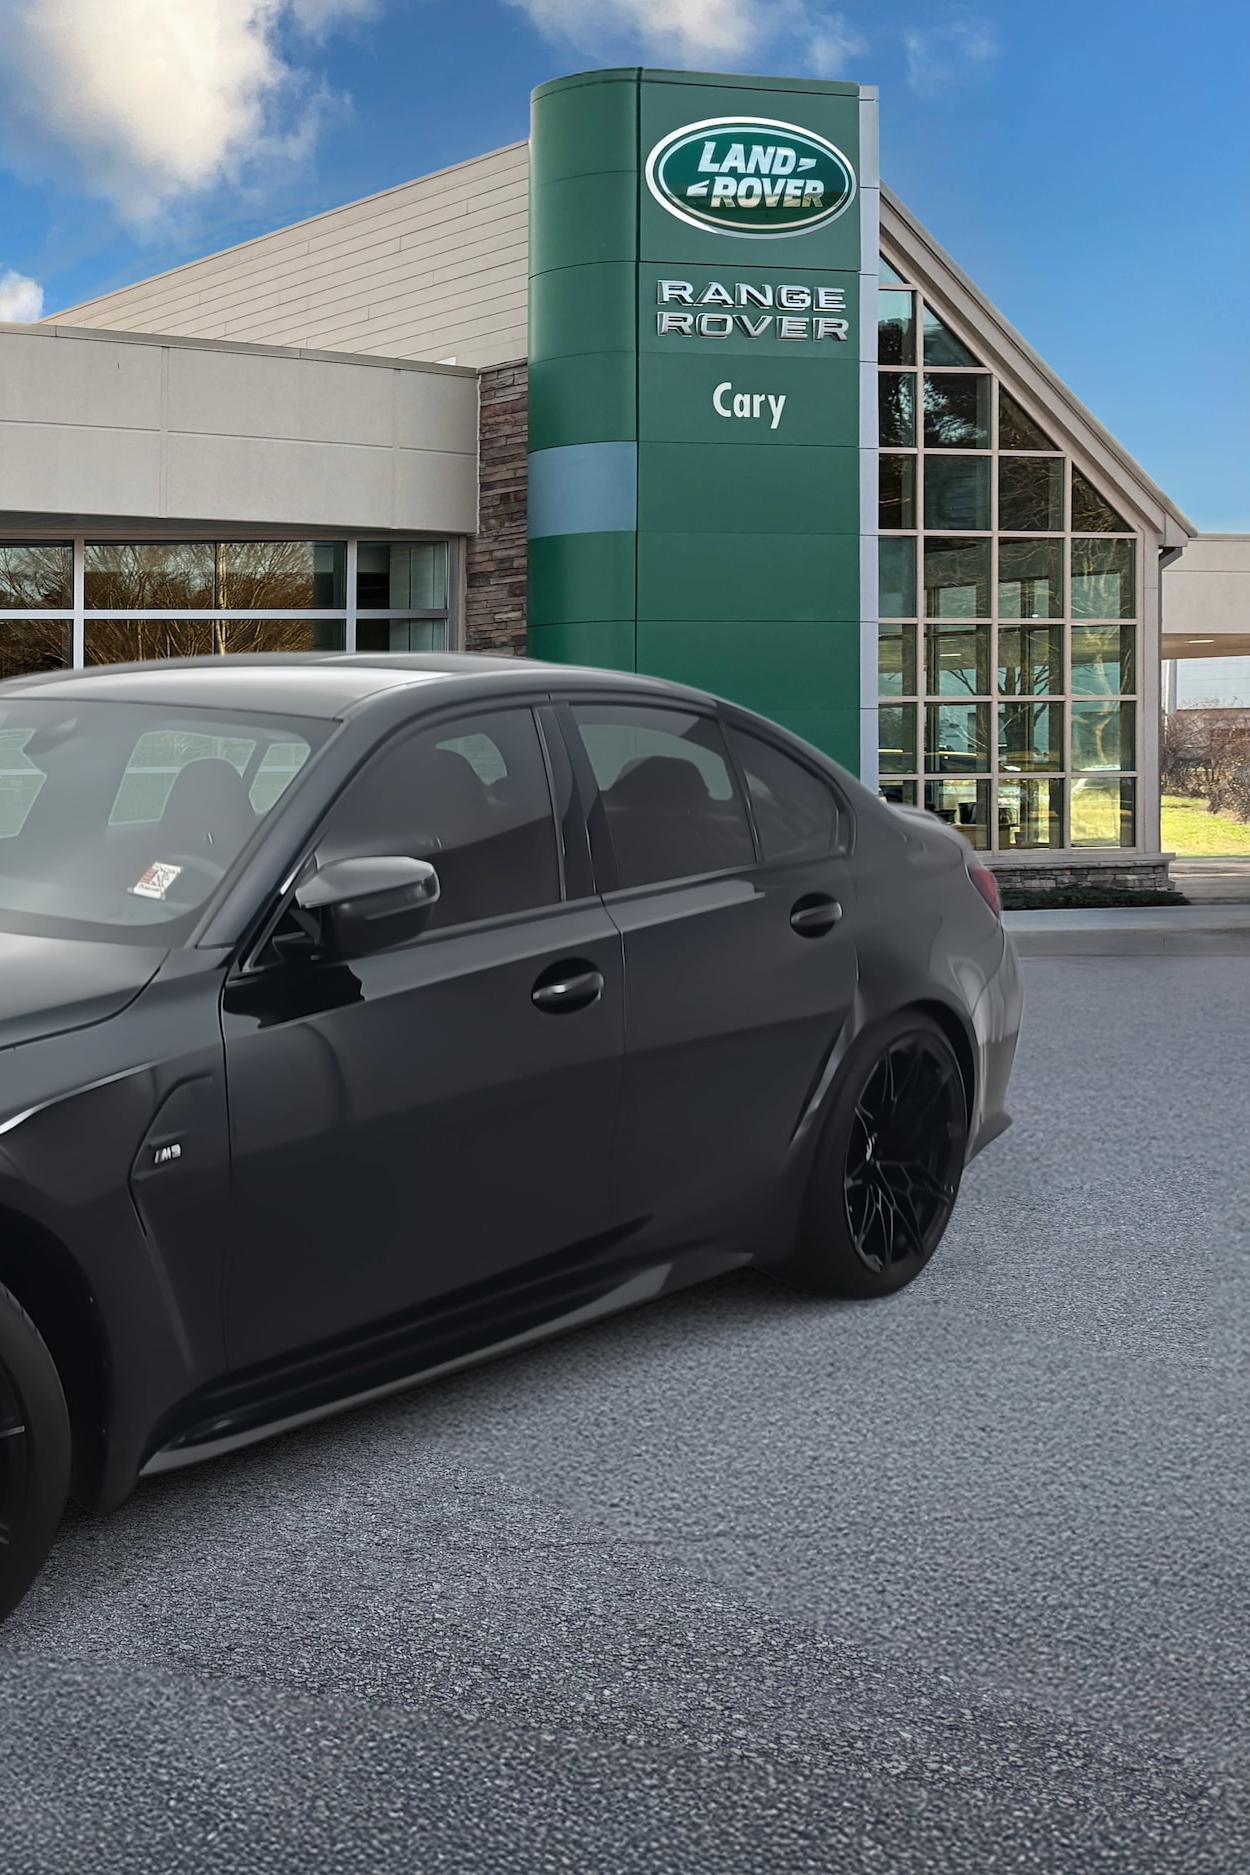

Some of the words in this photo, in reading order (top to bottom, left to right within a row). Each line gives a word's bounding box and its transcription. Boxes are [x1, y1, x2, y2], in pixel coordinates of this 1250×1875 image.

[697, 141, 798, 176] LAND
[709, 176, 825, 208] ROVER
[657, 279, 846, 312] RANGE
[657, 311, 849, 342] ROVER
[713, 381, 787, 430] Cary
